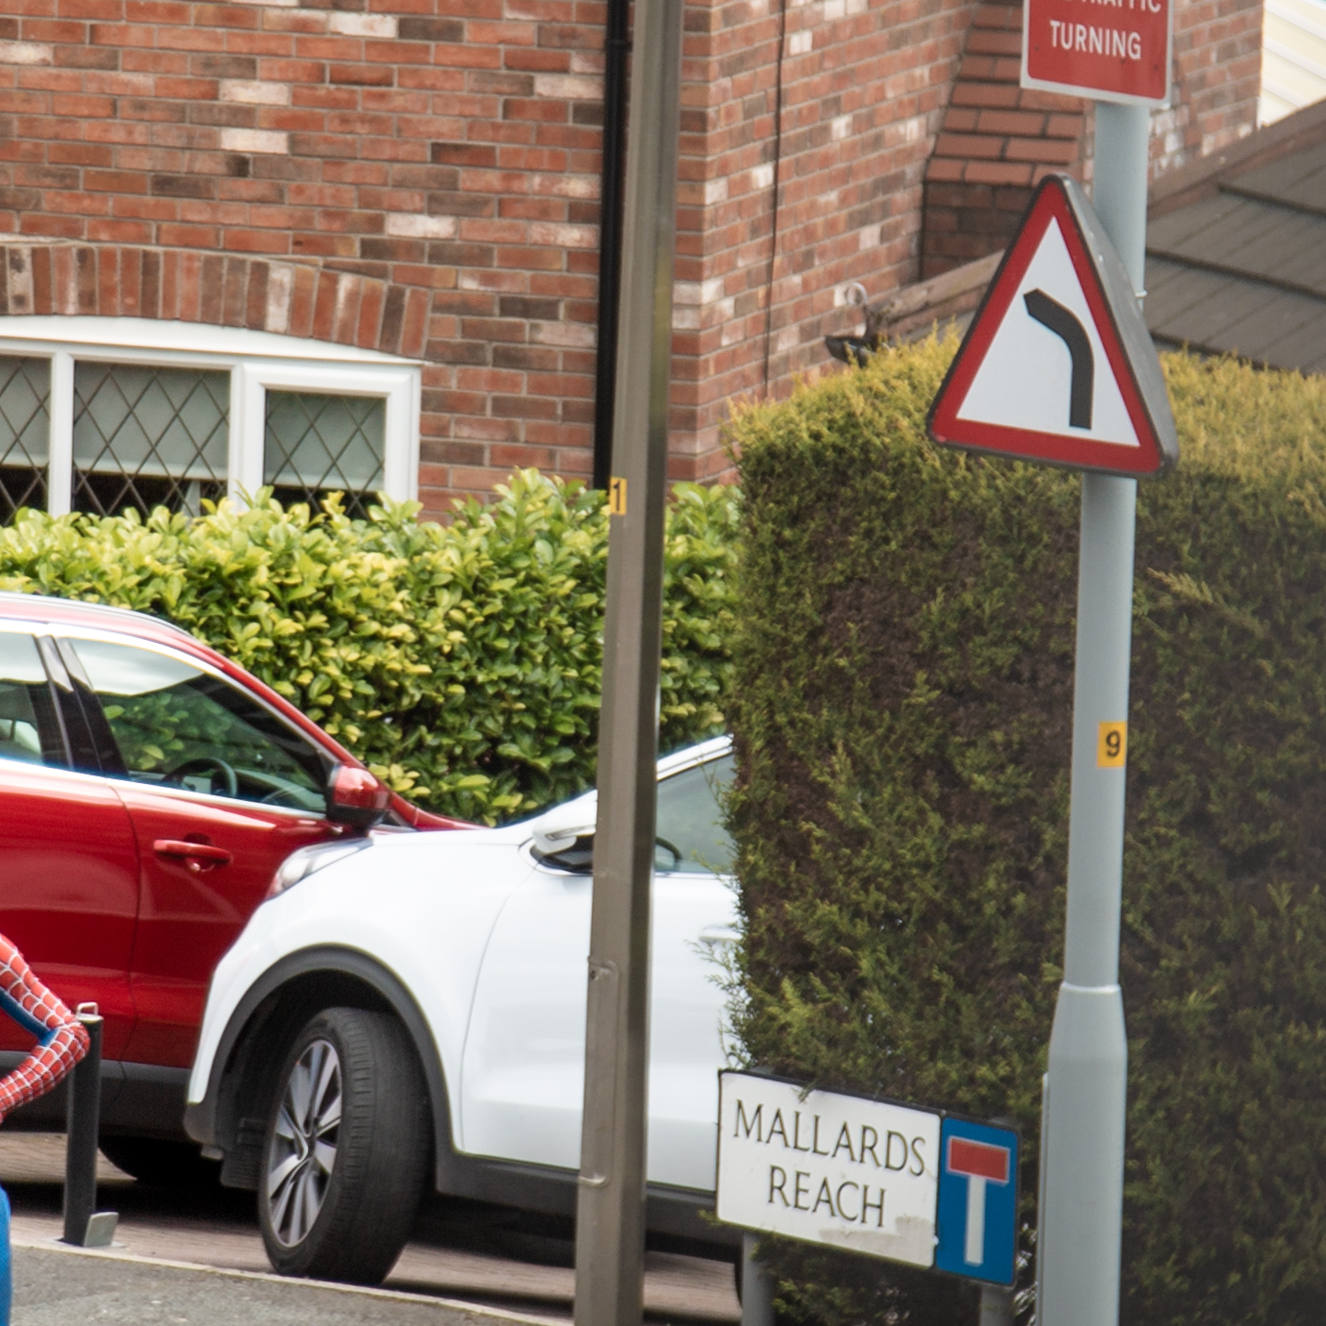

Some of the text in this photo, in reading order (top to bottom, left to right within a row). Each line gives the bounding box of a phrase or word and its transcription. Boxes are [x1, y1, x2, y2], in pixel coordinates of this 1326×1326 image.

[1050, 19, 1142, 60] TURNING
[613, 480, 621, 512] 1
[1105, 730, 1121, 758] 9
[733, 1098, 926, 1177] MALLARDS
[768, 1165, 886, 1228] REACH
